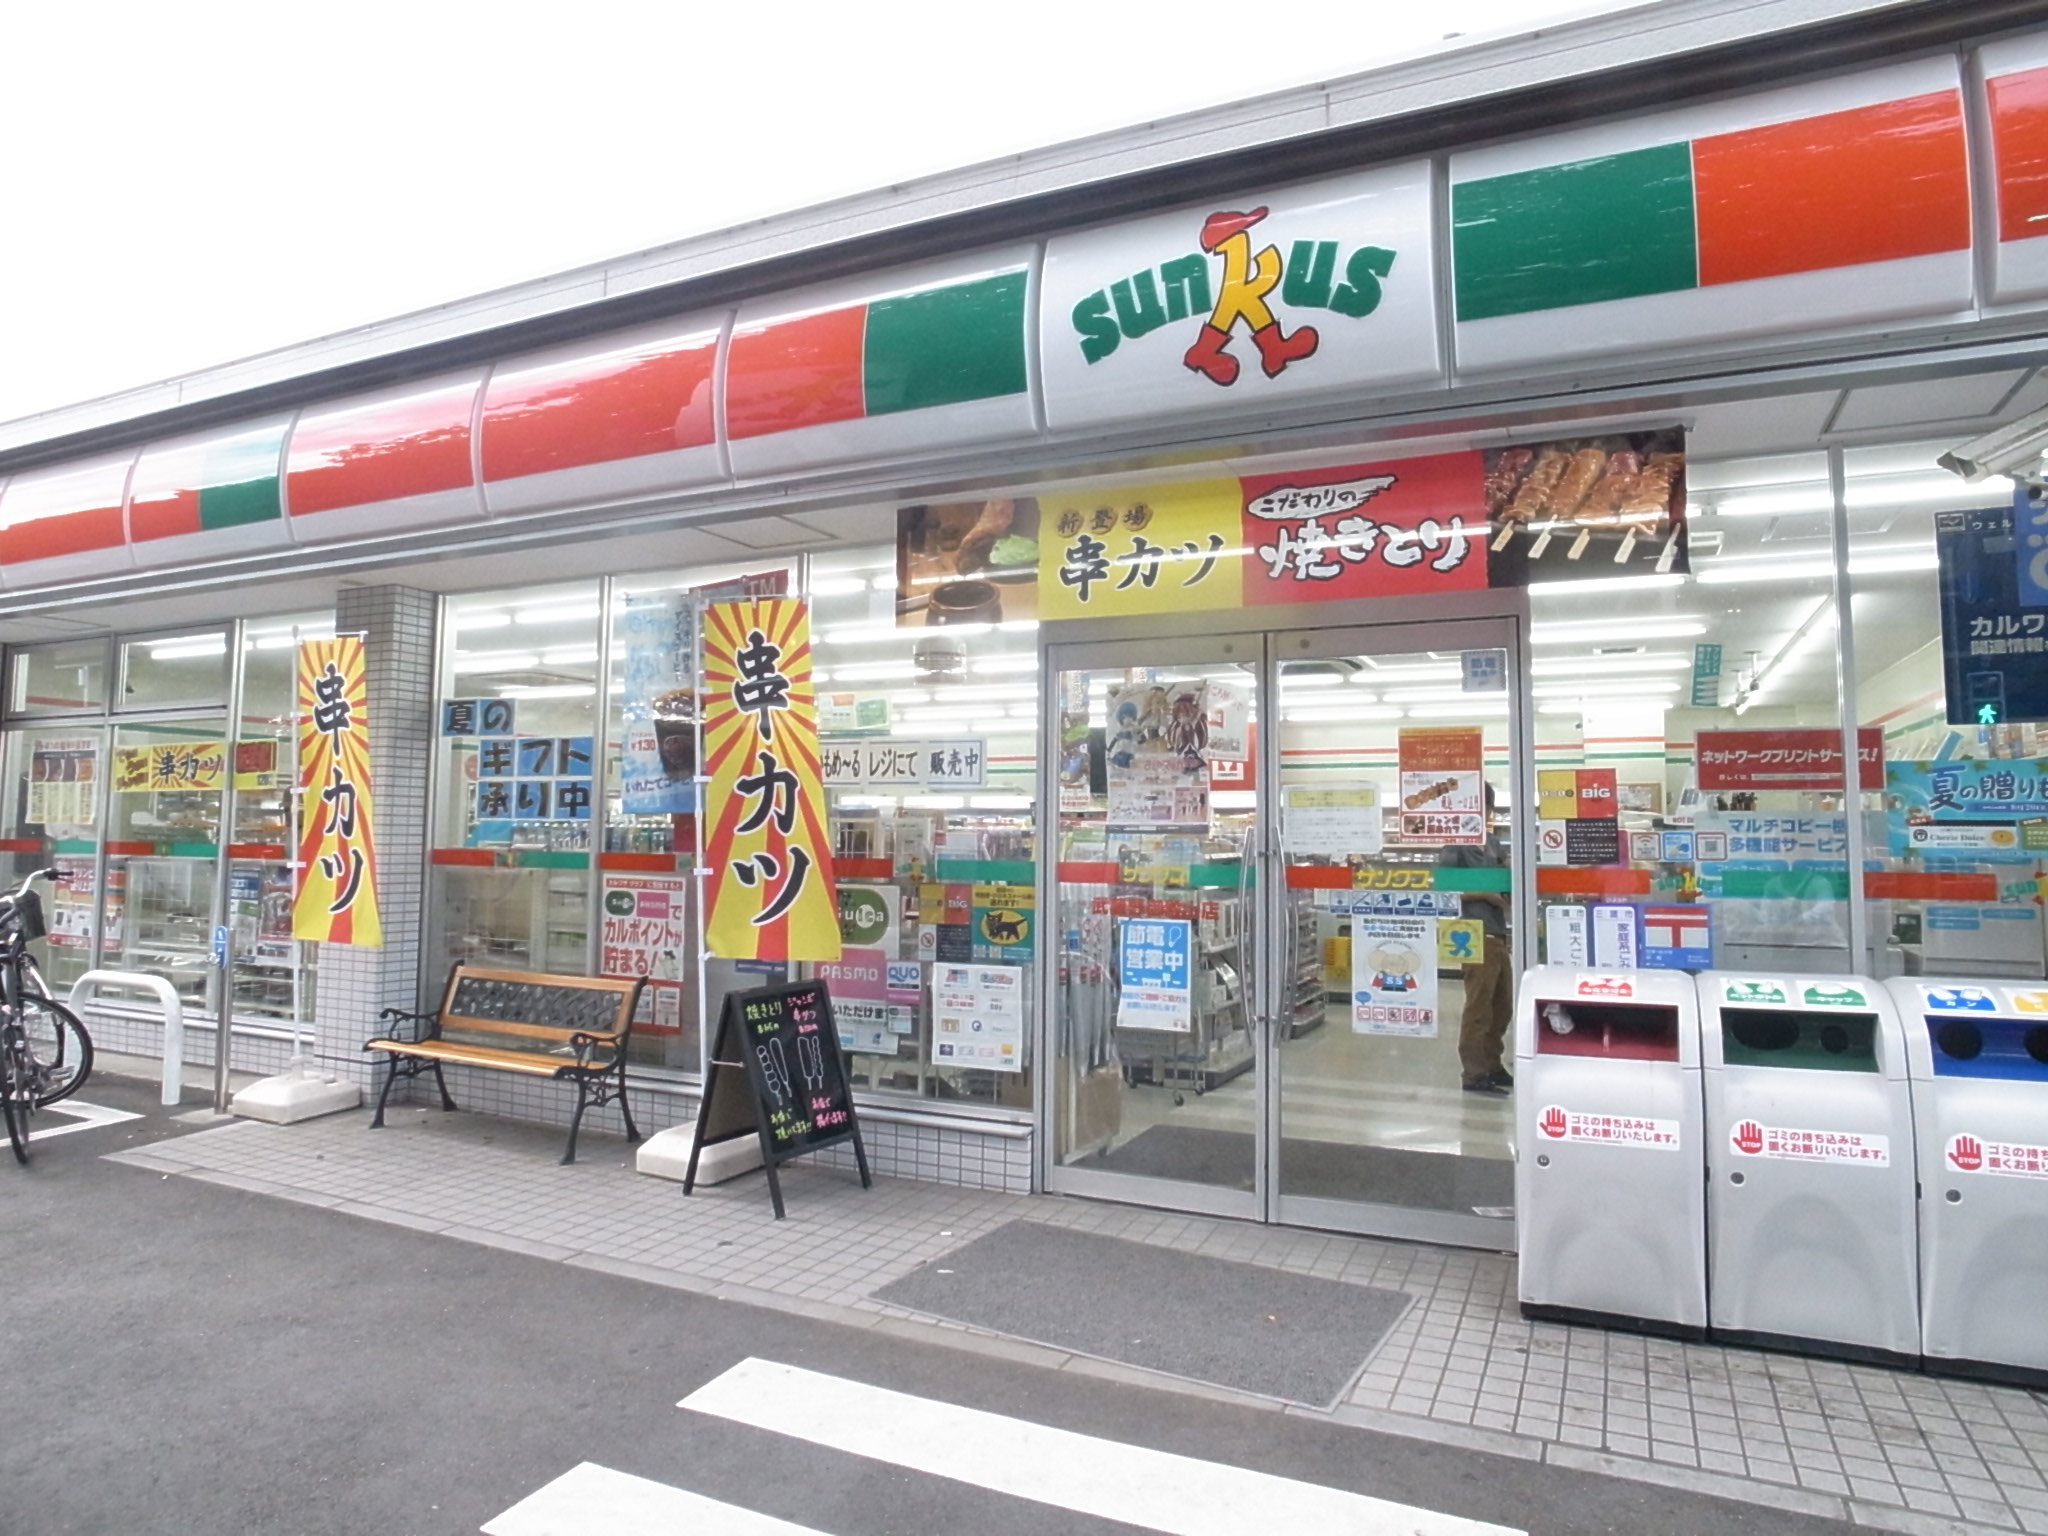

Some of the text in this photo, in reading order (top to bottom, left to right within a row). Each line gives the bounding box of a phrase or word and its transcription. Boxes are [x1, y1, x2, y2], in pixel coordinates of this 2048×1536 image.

[1261, 488, 1358, 513] こだわりの
[1056, 504, 1153, 537] 新登場
[1259, 517, 1470, 580] 焼きとり
[1059, 534, 1225, 602] 串カツ
[748, 577, 776, 596] TM
[1970, 637, 2048, 656] 関連情報
[446, 701, 511, 735] 夏の
[482, 740, 591, 776] ギフト
[868, 749, 918, 777] レジにて
[930, 747, 979, 777] 販売中
[1701, 747, 1879, 764] ネットワークプリントサース!
[158, 751, 225, 784] 串カツ
[732, 629, 812, 926] 串カツ
[313, 664, 366, 914] 串カツ
[481, 781, 590, 818] 承り中
[1356, 869, 1432, 889] サンクス
[671, 905, 682, 920] で
[838, 906, 884, 923] uica
[604, 918, 683, 948] カルポイントが
[603, 946, 658, 975] 貯まる!
[821, 965, 878, 981] PASMO
[888, 966, 919, 983] QUO
[833, 1004, 888, 1020] いただけま
[1547, 1125, 1565, 1133] STOP
[1571, 1115, 1655, 1131] ゴミの持ち込みは
[1571, 1126, 1678, 1145] 固くお断りいたします。
[1768, 1130, 1861, 1146] ゴミの持ち込みは
[1768, 1141, 1887, 1161] 固くお断りいたします。
